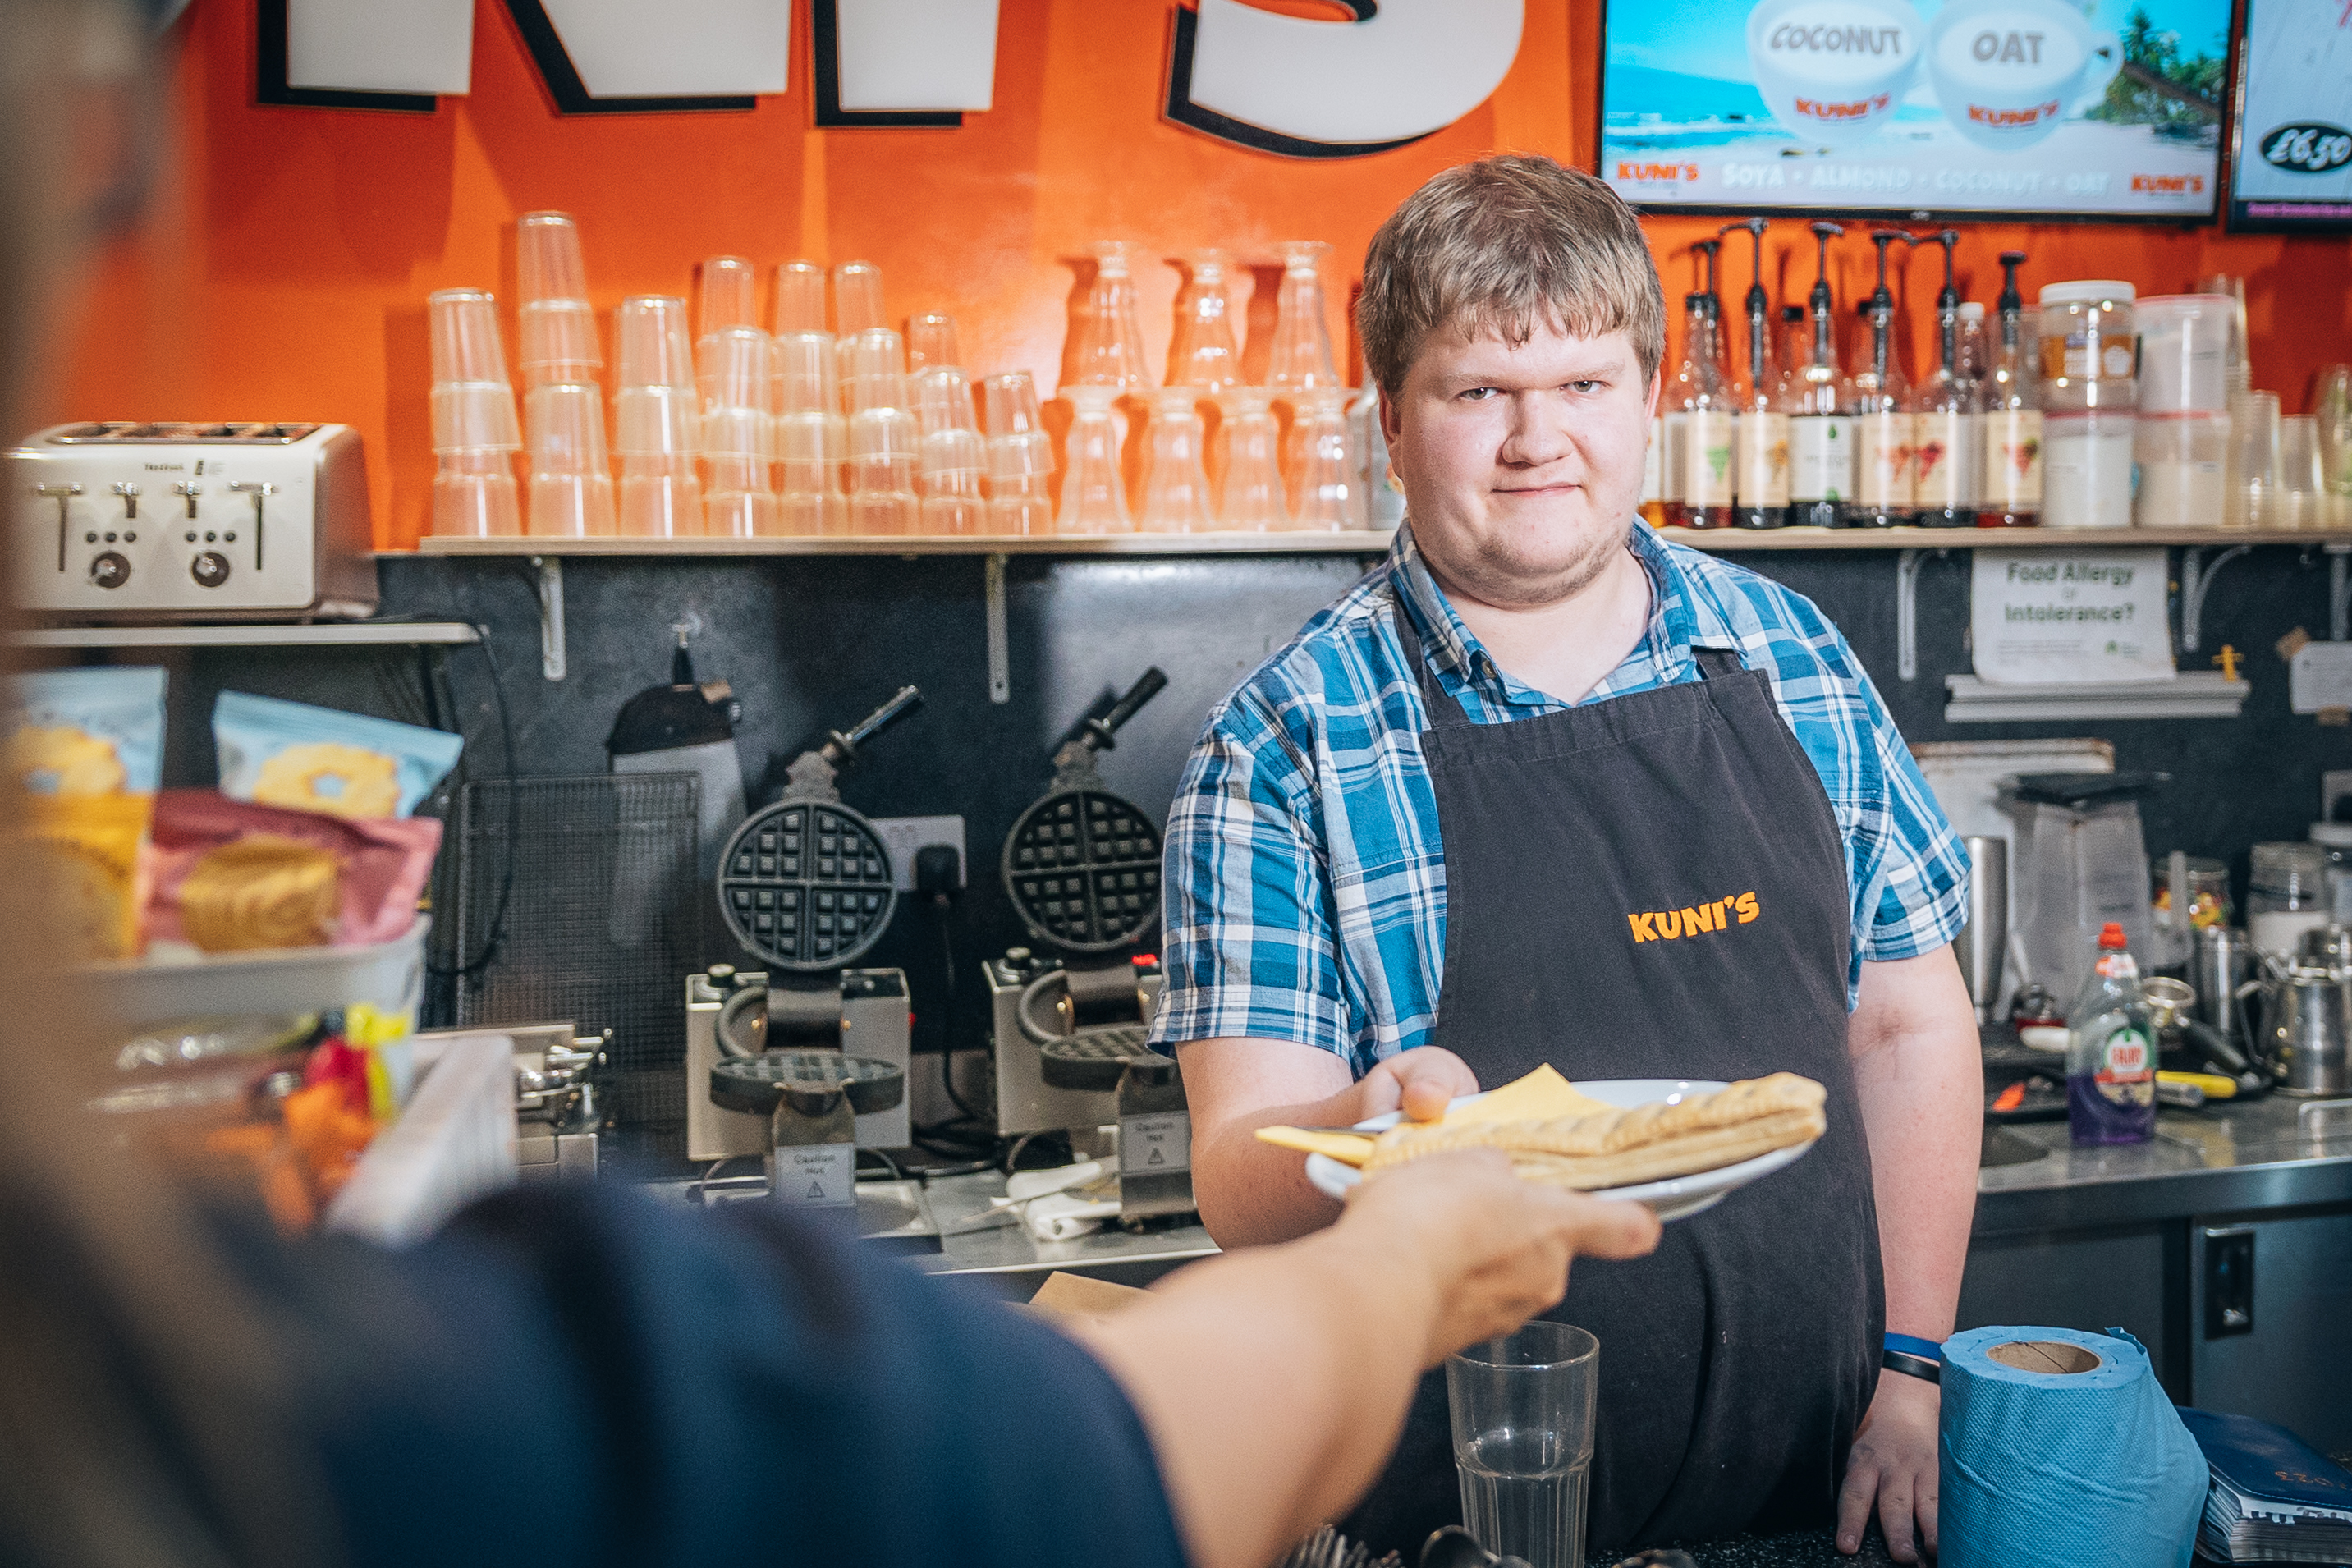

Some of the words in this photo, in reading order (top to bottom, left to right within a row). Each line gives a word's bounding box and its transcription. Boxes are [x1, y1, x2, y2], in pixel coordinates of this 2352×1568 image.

[1770, 22, 1901, 55] COCONUT
[1972, 30, 2046, 64] OAT
[1617, 162, 1699, 181] KUNI'S
[1722, 163, 1786, 190] SOYA
[1811, 164, 1913, 193] ALMOND
[1935, 169, 2043, 195] COCONUT
[2065, 172, 2111, 197] OAT
[2130, 174, 2205, 194] KUNI'S
[2007, 562, 2058, 583] Food
[2061, 562, 2134, 589] Allergy
[2005, 603, 2134, 621] Intolerance?
[1627, 891, 1760, 943] KUNI'S
